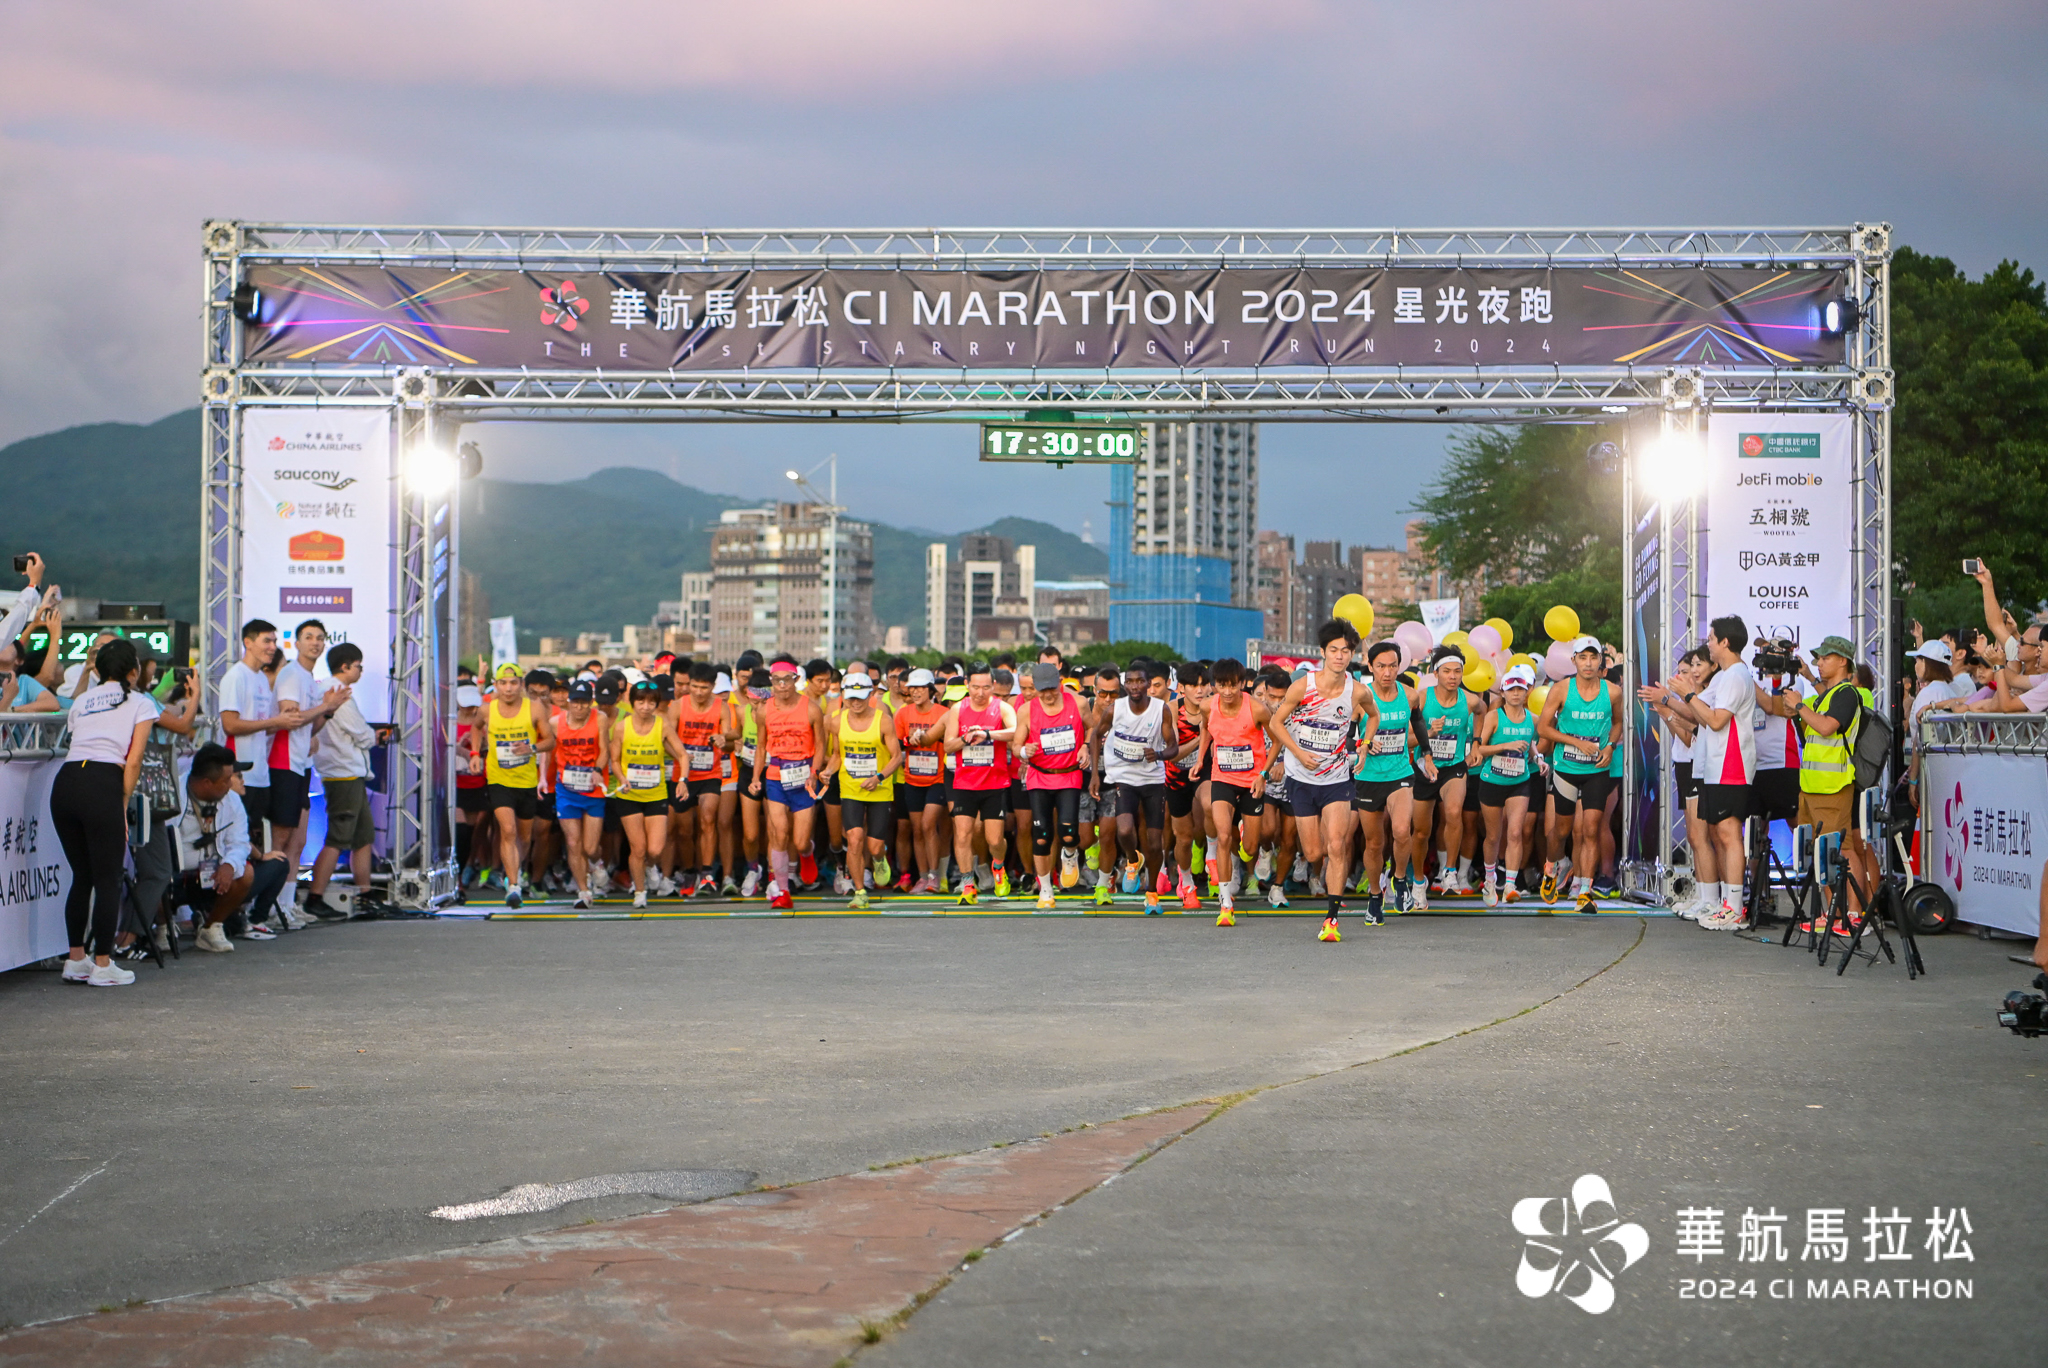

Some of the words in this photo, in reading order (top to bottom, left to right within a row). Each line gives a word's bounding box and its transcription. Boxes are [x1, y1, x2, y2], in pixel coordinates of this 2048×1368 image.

[610, 286, 829, 331] 華航馬拉松
[843, 290, 887, 325] CI
[912, 289, 1214, 326] MARATHON
[1242, 289, 1375, 323] 2024
[1393, 286, 1552, 324] 星光夜跑
[544, 341, 627, 358] THE
[823, 340, 1015, 356] STARRY
[1076, 340, 1230, 355] NIGHT
[1290, 339, 1374, 353] RUN
[1434, 339, 1550, 353] 2024
[286, 443, 317, 451] CHINA
[320, 443, 362, 451] AIRLINES
[988, 431, 1134, 456] 17:30:00
[274, 469, 340, 483] saucony
[1737, 472, 1771, 486] JetFi
[1775, 472, 1823, 486] mobile
[1749, 586, 1809, 598] LOUISA
[1759, 600, 1800, 610] COFFEE
[0, 815, 38, 860] 華航空
[1974, 806, 2031, 858] 華航馬拉松
[8, 863, 60, 905] AIRLINES
[1973, 865, 1989, 883] 2024
[1997, 868, 2031, 890] MARATHON
